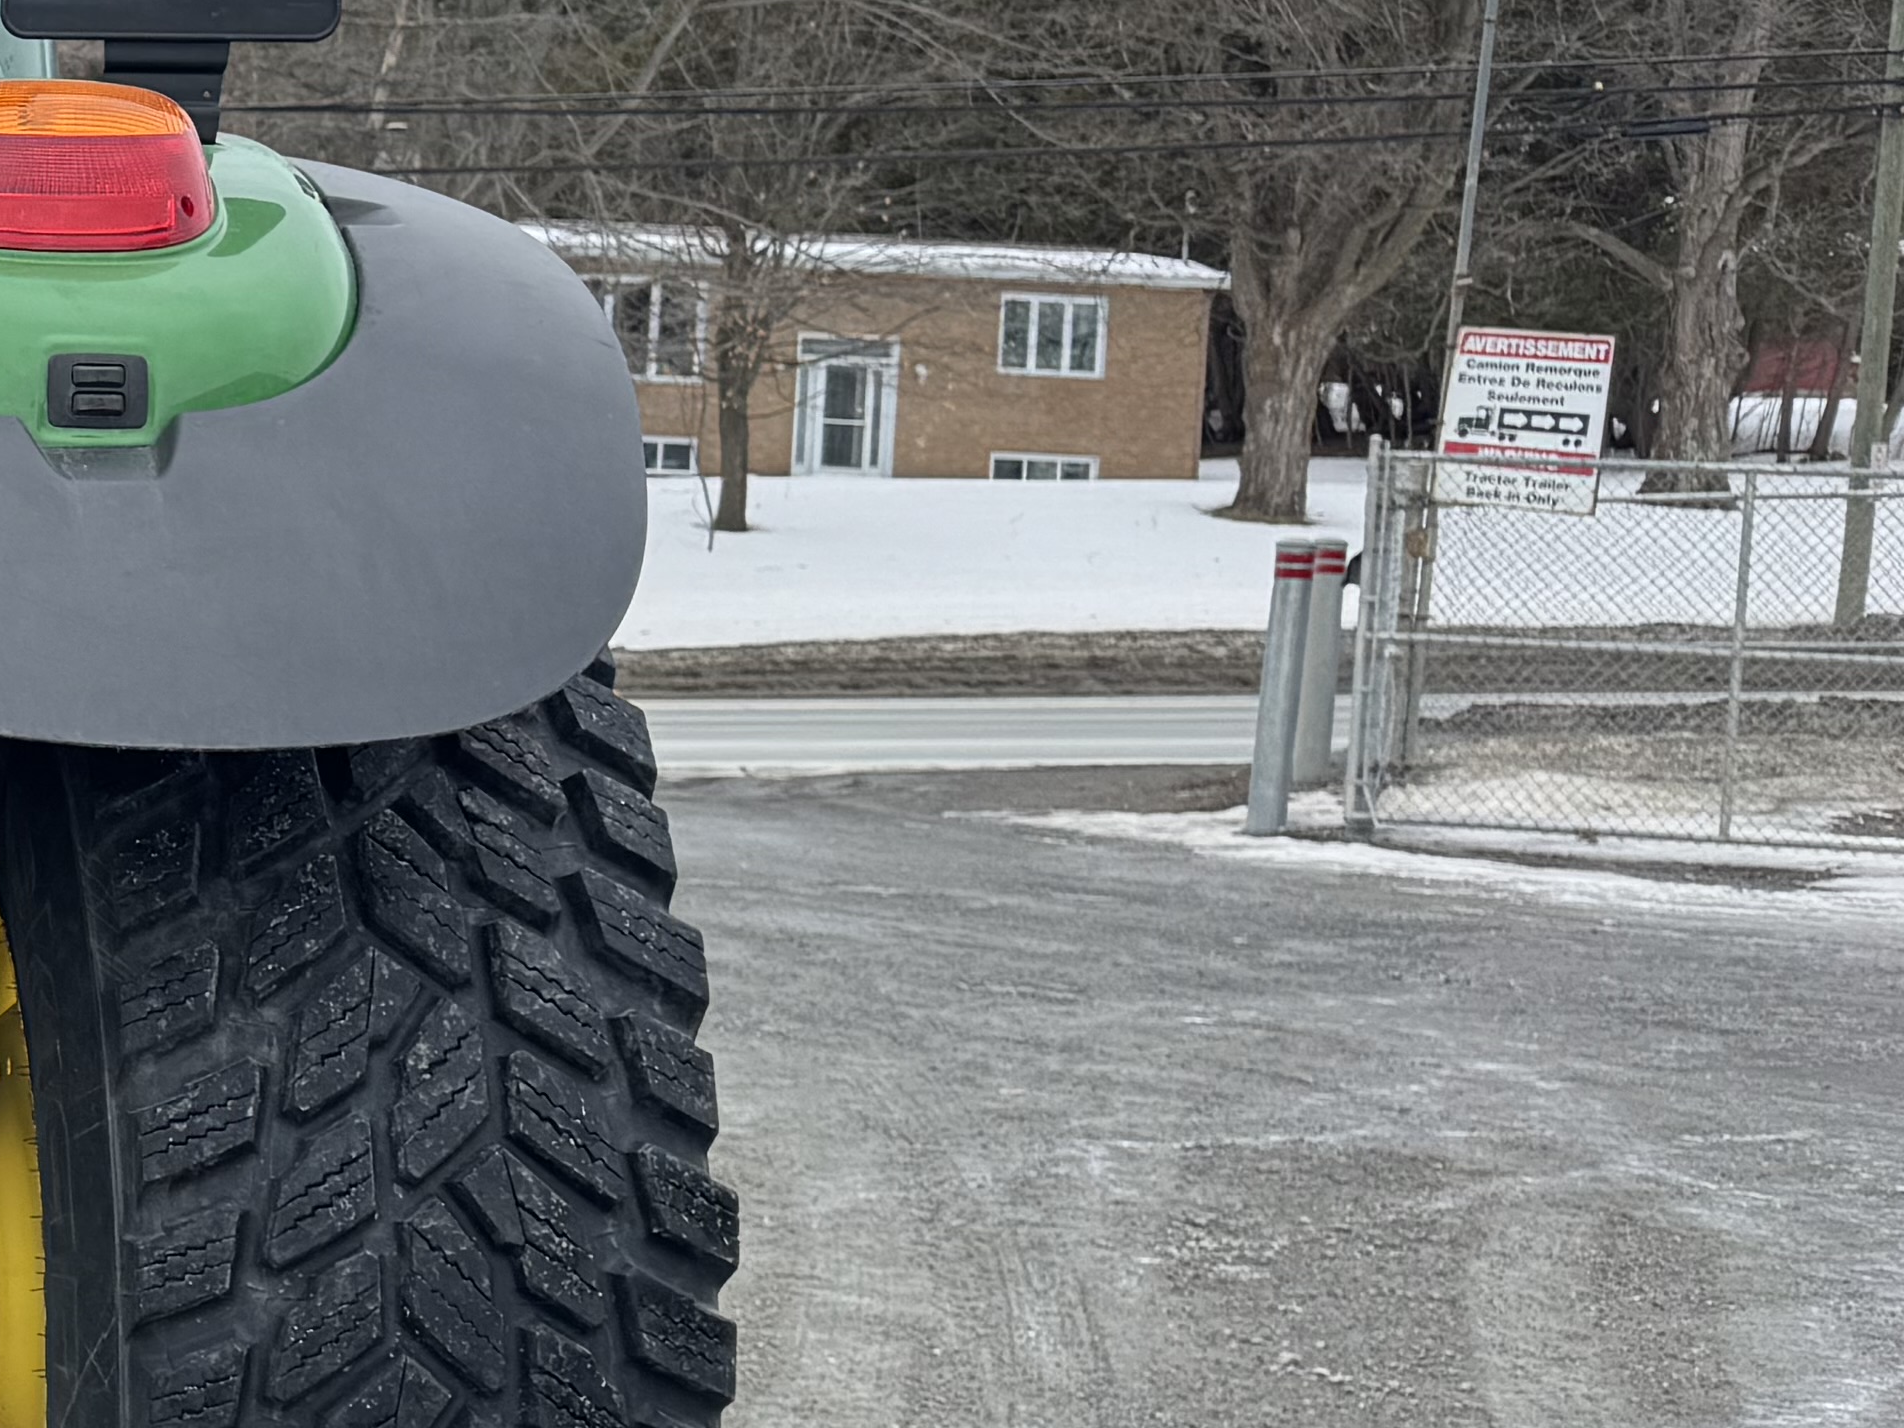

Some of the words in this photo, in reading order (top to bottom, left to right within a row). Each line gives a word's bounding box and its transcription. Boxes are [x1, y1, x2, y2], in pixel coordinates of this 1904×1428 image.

[1463, 334, 1609, 360] AVERTISSEMENT
[1466, 358, 1520, 372] Camion
[1525, 362, 1600, 378] Remorque
[1536, 378, 1603, 393] Reculons
[1487, 390, 1565, 406] Seulement
[1523, 475, 1570, 491] Trailer
